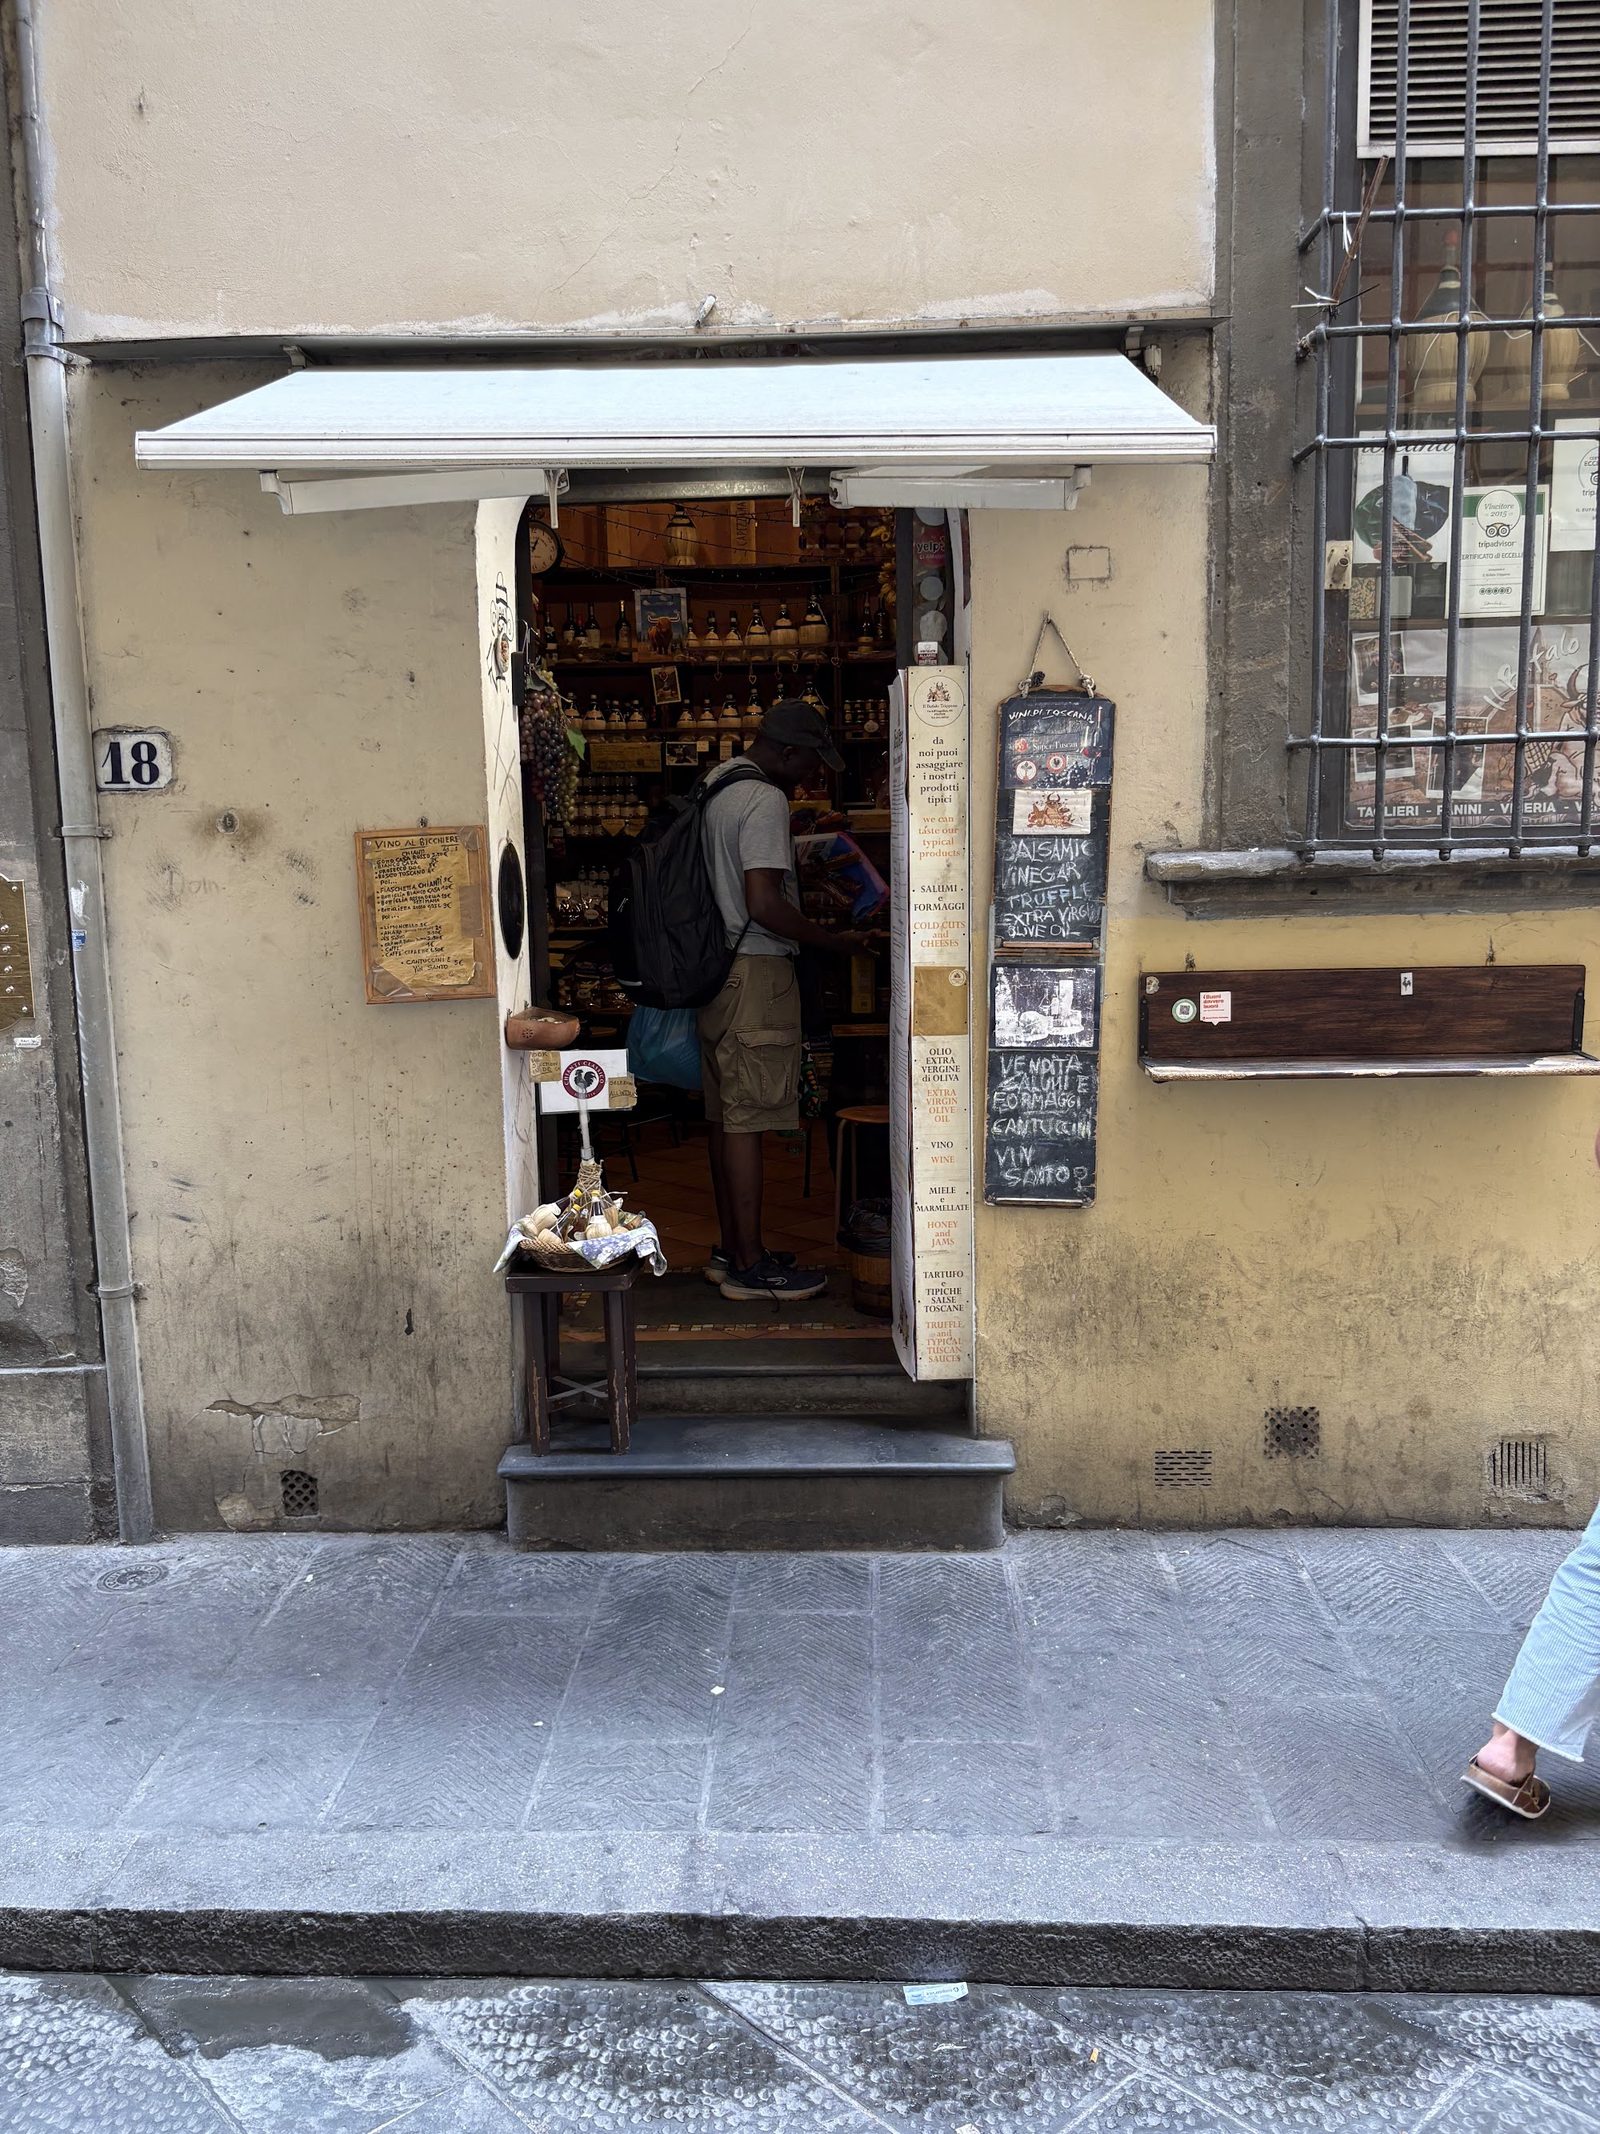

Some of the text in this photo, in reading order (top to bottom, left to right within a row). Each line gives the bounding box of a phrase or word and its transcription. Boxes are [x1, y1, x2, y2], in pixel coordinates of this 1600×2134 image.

[1484, 503, 1514, 511] Vincitore
[917, 543, 940, 554] yelp
[1478, 541, 1515, 550] tripadvisor
[1461, 553, 1494, 561] ERTIFICATO
[1497, 630, 1581, 691] Bfalo
[1045, 709, 1095, 725] TOSCANA
[932, 736, 944, 745] da
[919, 748, 958, 760] noi puoi
[102, 741, 160, 785] 18
[916, 760, 963, 772] assaggiare
[923, 771, 956, 780] i nostri
[920, 783, 959, 795] prodotti
[927, 795, 952, 806] tipici
[1357, 801, 1556, 818] TALIERI PNINI VIERIA
[938, 815, 954, 823] can
[919, 827, 940, 835] taste
[375, 840, 401, 849] VINO
[419, 836, 459, 847] BICCHIERE
[922, 838, 954, 849] typical
[919, 848, 960, 860] products
[920, 884, 957, 893] SALUMI
[1008, 882, 1091, 910] TRUFFLE
[914, 902, 965, 911] FORMAGGI
[914, 920, 966, 930] COLD CUTS
[932, 930, 949, 938] and
[920, 939, 959, 948] CHEESES
[929, 1048, 952, 1056] OLIO
[926, 1056, 955, 1065] EXTRA
[921, 1065, 960, 1073] VERGINE
[922, 1073, 960, 1082] di OLIVA
[927, 1089, 957, 1097] EXTRA
[926, 1097, 958, 1105] VIRGIN
[929, 1106, 956, 1114] OLIVE
[934, 1115, 951, 1123] OIL
[930, 1141, 954, 1149] VINO
[931, 1156, 955, 1164] WINE
[929, 1186, 956, 1195] MIELE
[916, 1204, 970, 1212] MARMELLATE
[927, 1221, 958, 1229] HONEY
[931, 1238, 955, 1248] JAMS
[923, 1270, 964, 1279] TARTUFO
[925, 1287, 962, 1296] TIPICHE
[931, 1296, 956, 1304] SALSE
[924, 1304, 964, 1313] TOSCANE
[926, 1321, 962, 1329] TRUFFLE
[937, 1329, 952, 1337] and
[927, 1338, 962, 1346] TYPICAL
[927, 1346, 962, 1354] TUSCAN
[928, 1355, 960, 1363] SAUCES
